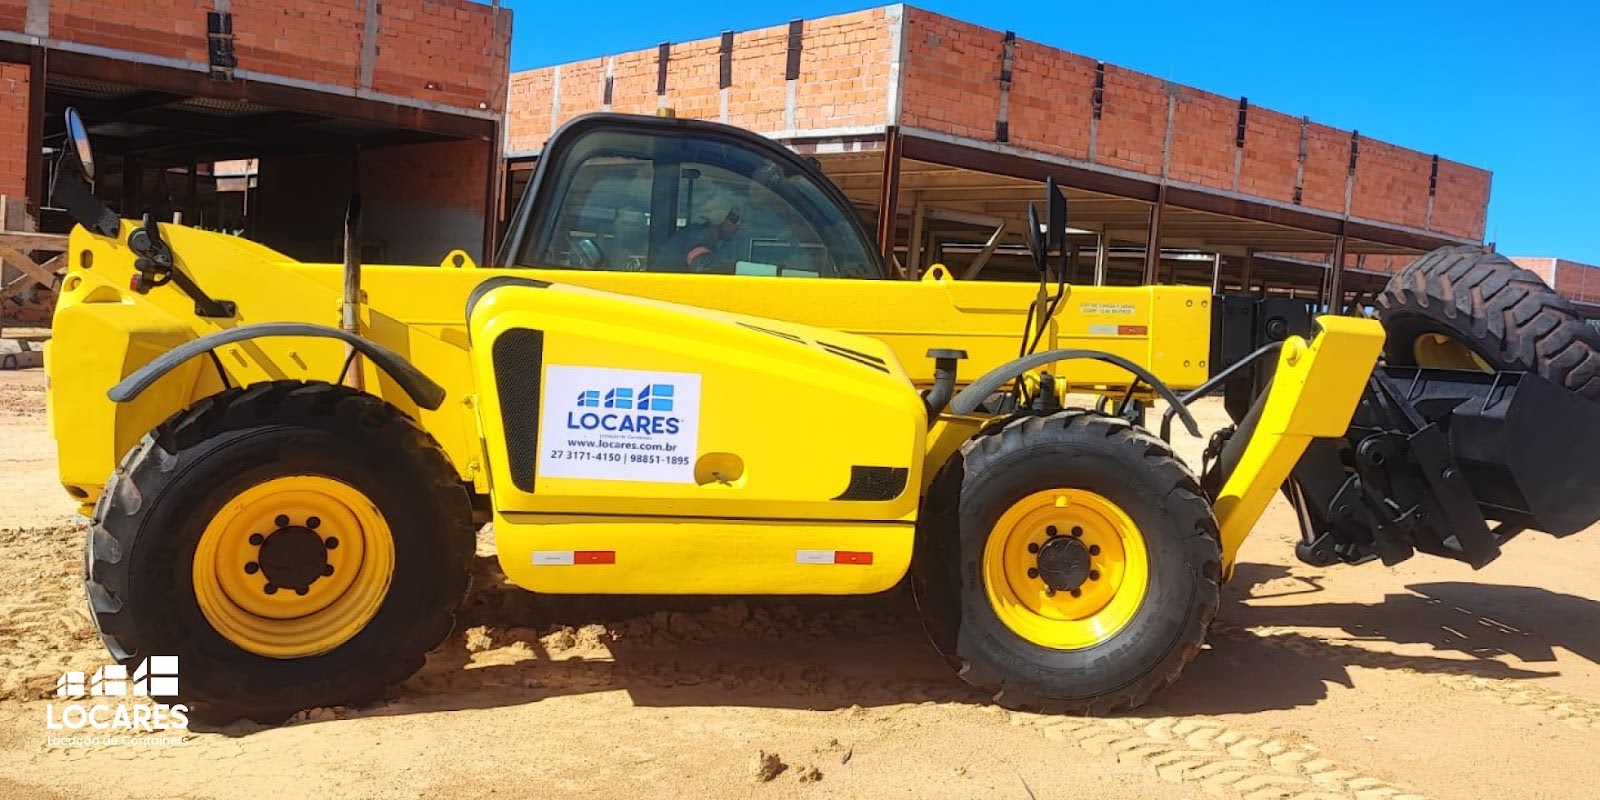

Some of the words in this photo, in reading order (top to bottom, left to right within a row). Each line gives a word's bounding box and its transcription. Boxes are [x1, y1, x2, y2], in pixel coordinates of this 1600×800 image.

[567, 411, 680, 435] LOCARES
[567, 439, 678, 452] www.locares.com.br
[551, 450, 564, 459] 27
[566, 451, 621, 462] 3171-4150
[630, 454, 690, 465] 98851-1895
